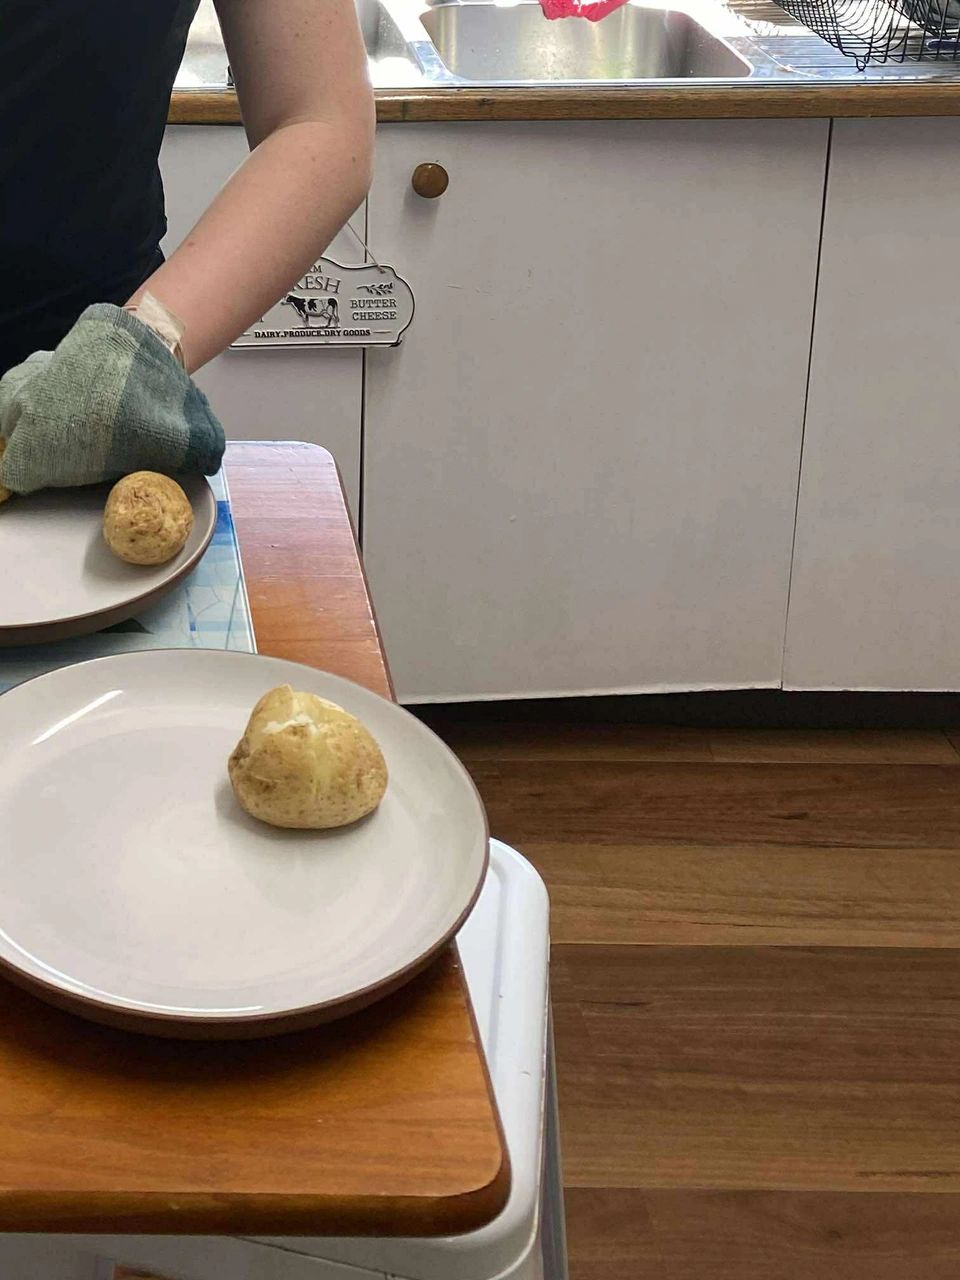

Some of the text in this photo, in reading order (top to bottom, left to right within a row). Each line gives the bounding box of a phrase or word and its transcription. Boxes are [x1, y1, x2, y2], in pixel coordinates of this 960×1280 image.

[296, 275, 341, 294] ESH
[349, 298, 397, 309] BUTTER
[352, 310, 397, 321] CHEESE
[342, 329, 371, 337] GOODS
